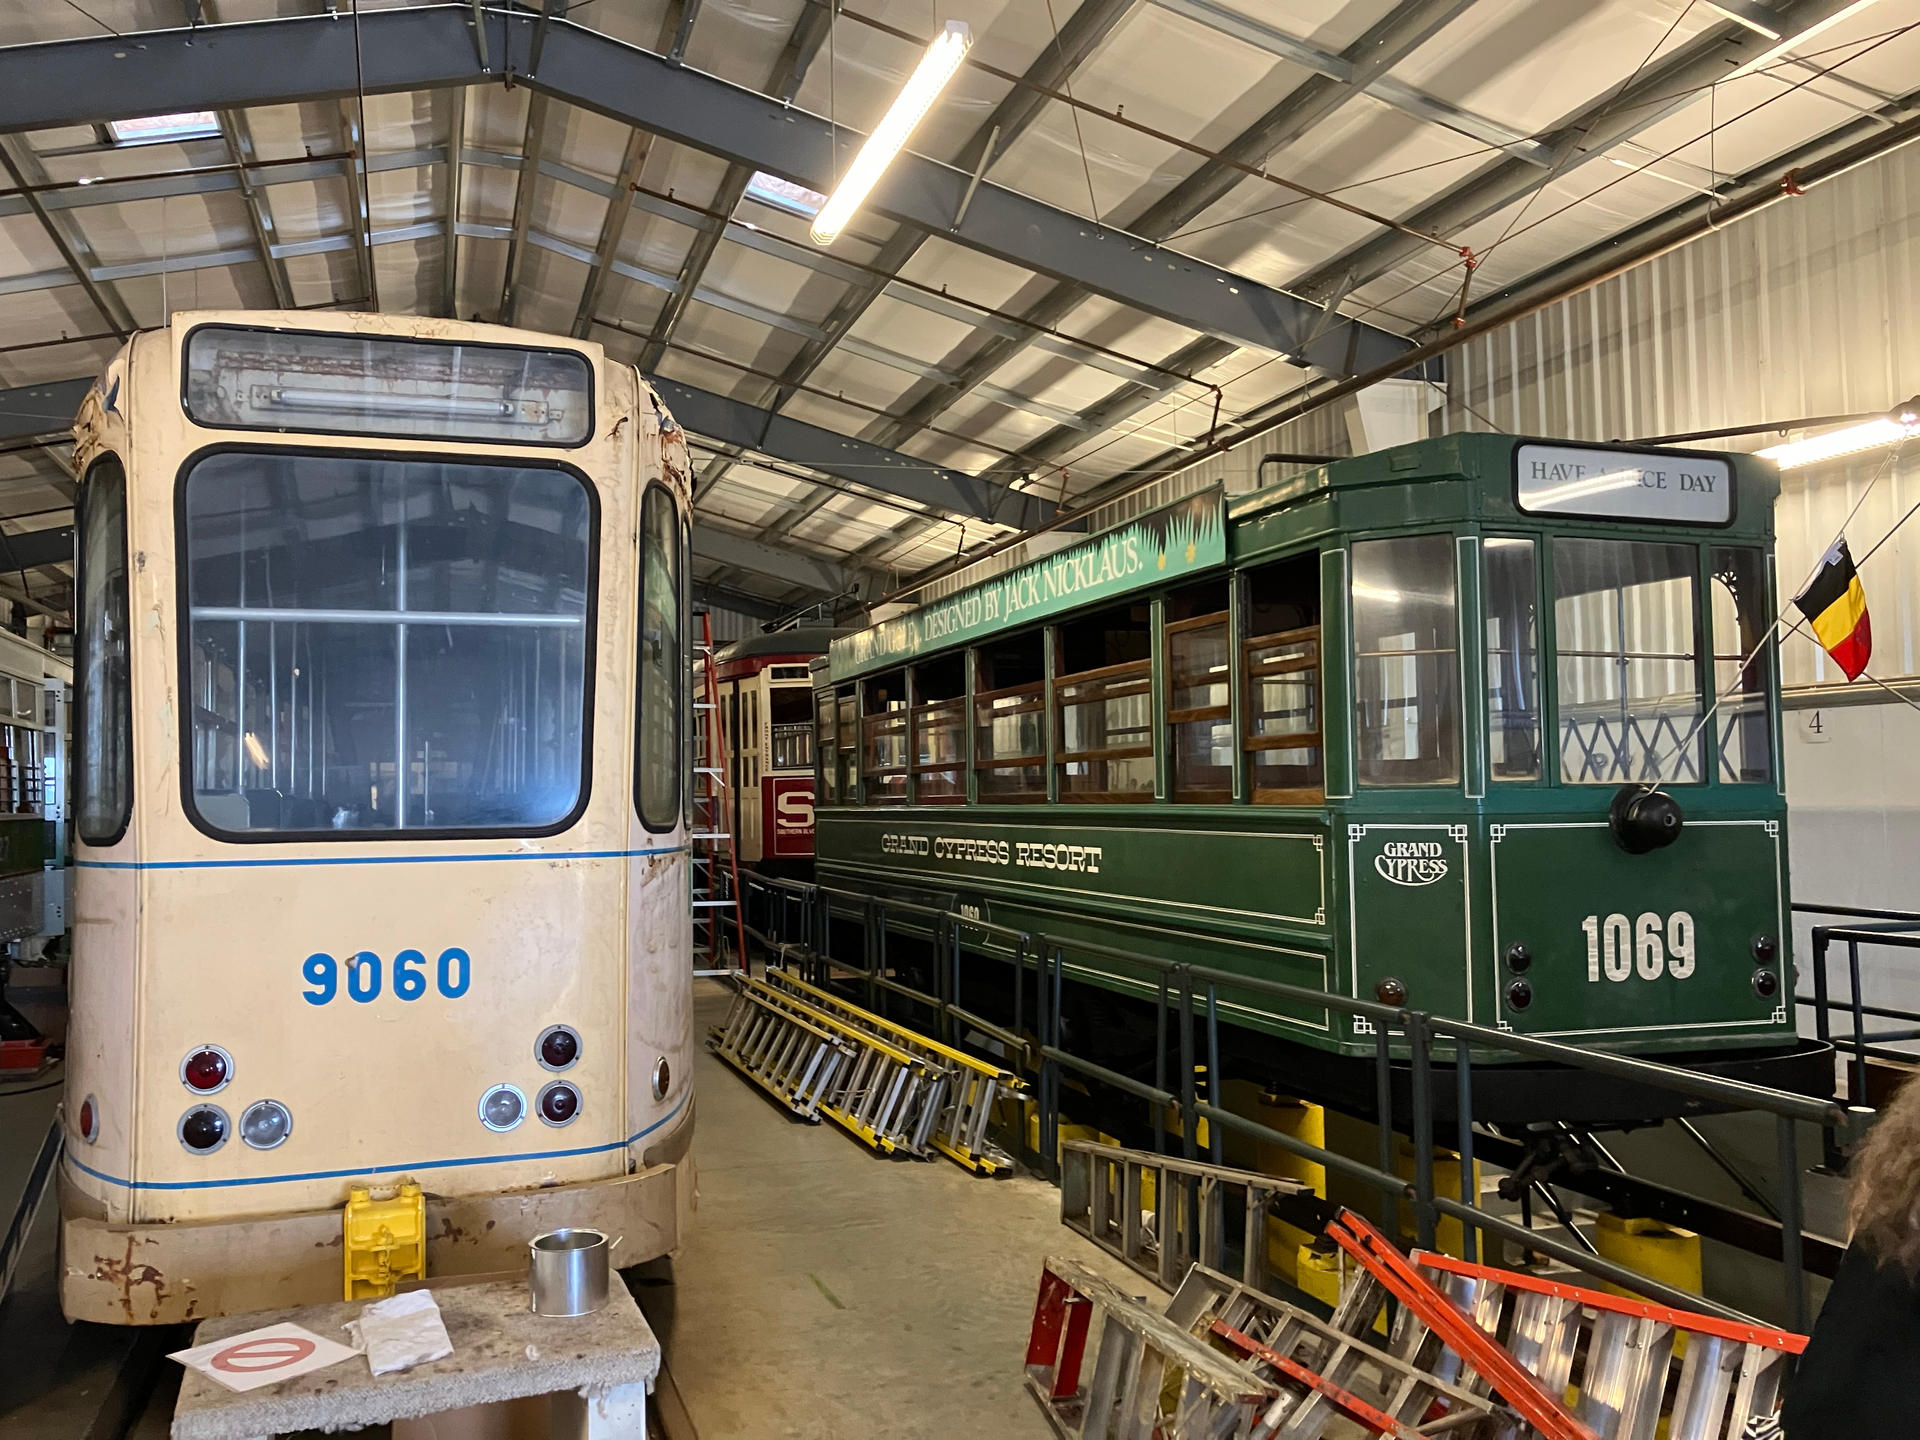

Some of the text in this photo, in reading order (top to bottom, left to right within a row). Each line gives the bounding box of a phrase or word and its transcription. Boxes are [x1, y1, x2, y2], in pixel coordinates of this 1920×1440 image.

[1679, 473, 1717, 493] DAY
[924, 597, 982, 641] DESIGNED
[984, 588, 1002, 623] BY
[1003, 573, 1042, 623] JACK
[1043, 536, 1144, 602] NICKLAUS.
[1808, 710, 1823, 734] 4
[777, 791, 815, 827] S
[881, 833, 1102, 874] GRAND CYPRESS RESORT
[1383, 842, 1443, 857] GRAND
[1374, 854, 1449, 887] CYPRESS
[1581, 910, 1696, 982] 1069
[302, 947, 471, 1006] 9060
